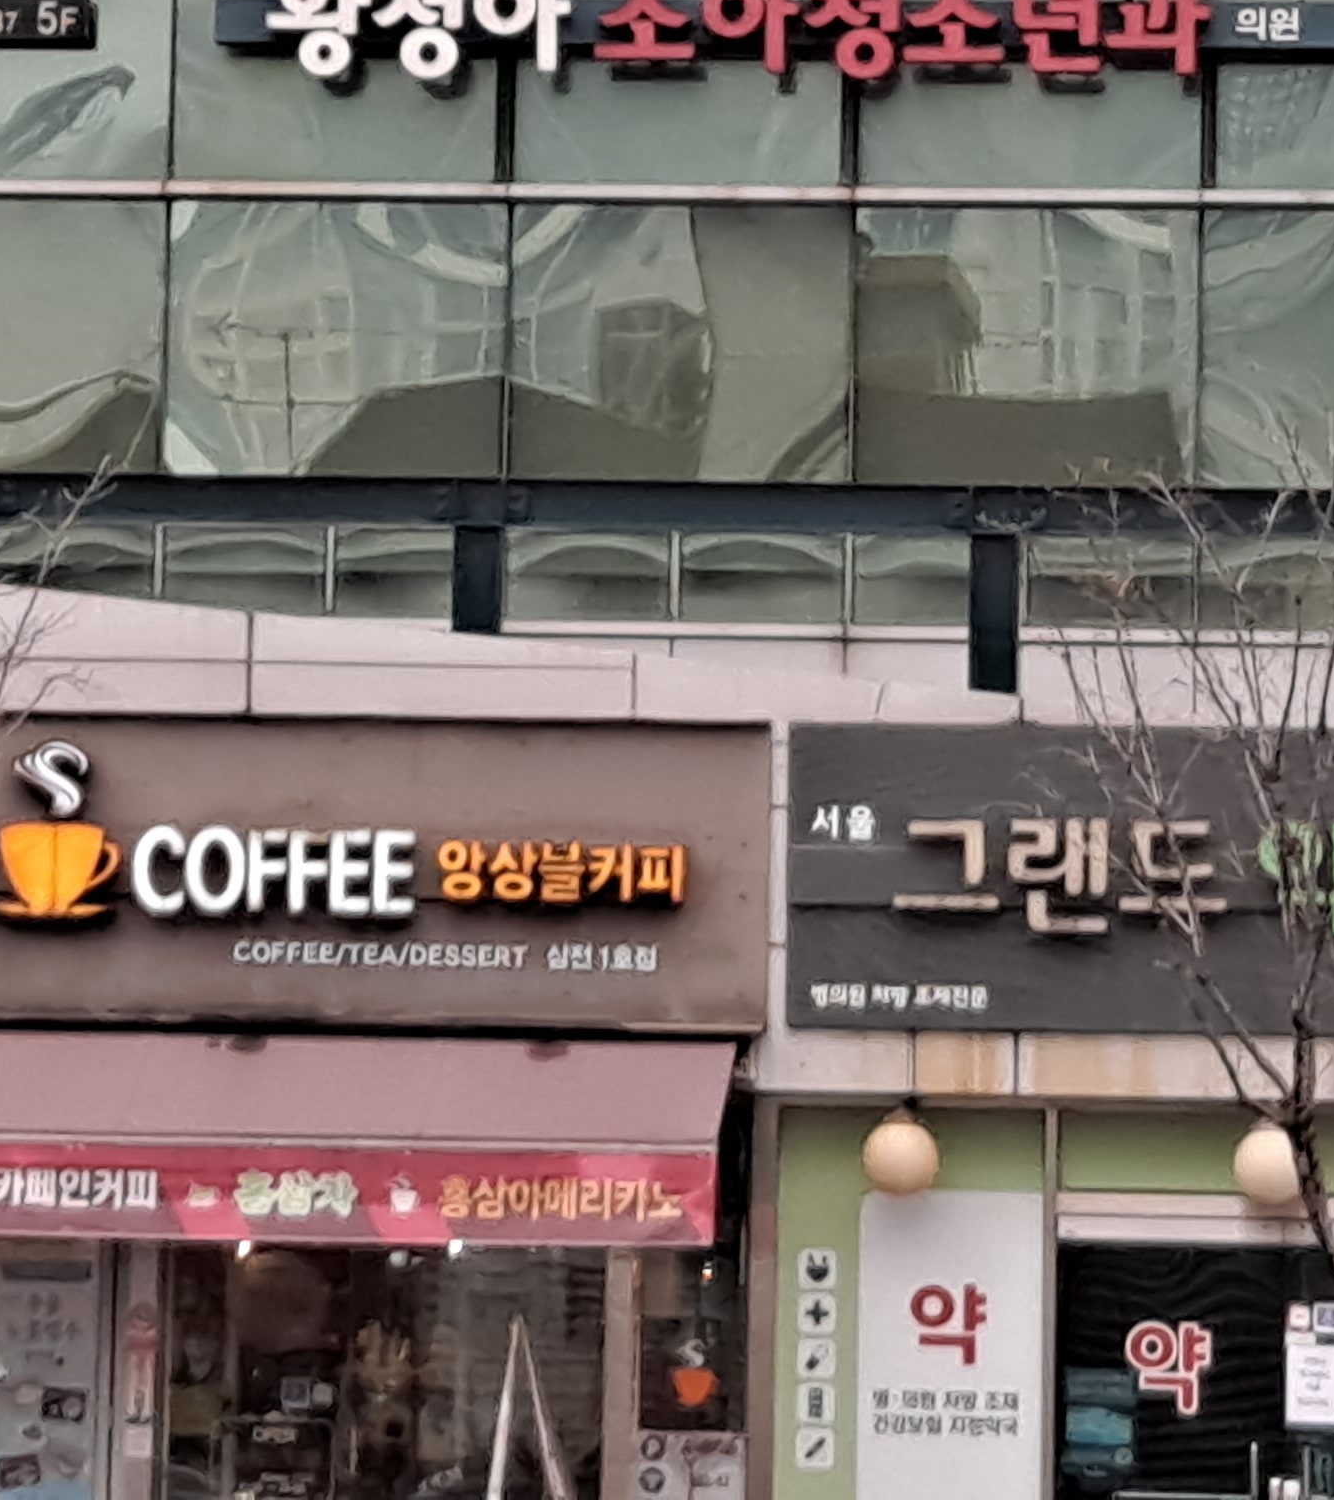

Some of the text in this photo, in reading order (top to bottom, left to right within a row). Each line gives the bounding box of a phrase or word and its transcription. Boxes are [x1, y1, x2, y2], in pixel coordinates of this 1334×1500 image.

[36, 0, 79, 36] 5F
[1234, 8, 1300, 42] 의원
[811, 804, 876, 841] 서울
[131, 825, 417, 920] COFFEE
[437, 840, 687, 903] 앙상블커피
[892, 817, 1228, 935] 그랜드
[233, 941, 528, 970] COFFEE/TEA/DESSERT
[440, 1174, 685, 1222] 홍삼아메리카노
[910, 1283, 988, 1367] 약
[1125, 1320, 1212, 1416] 약
